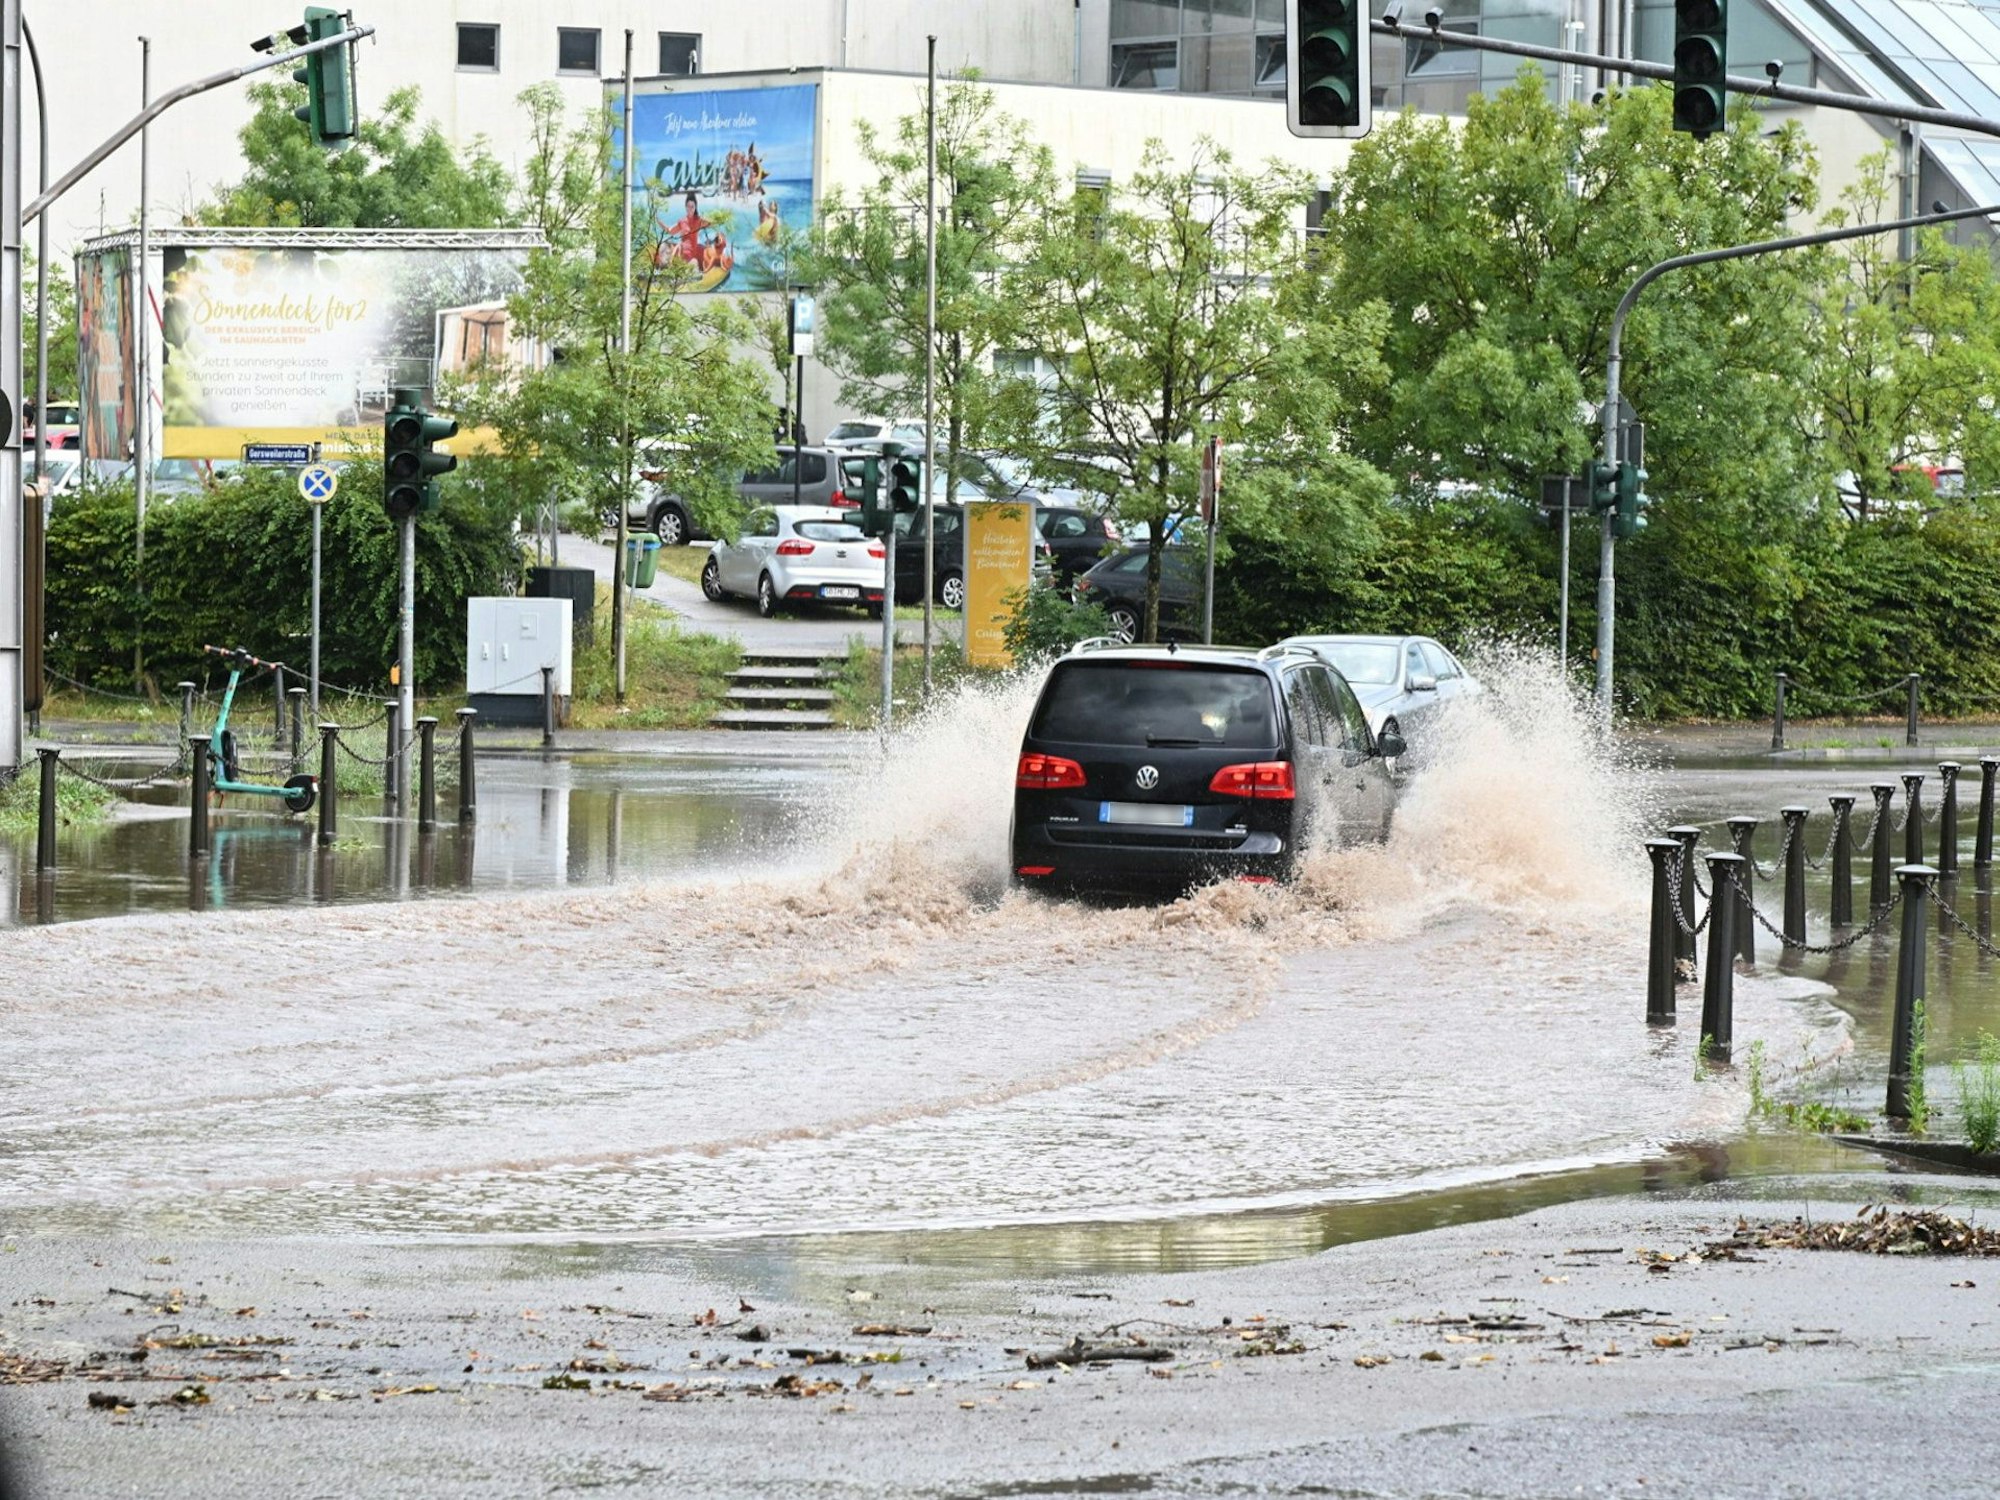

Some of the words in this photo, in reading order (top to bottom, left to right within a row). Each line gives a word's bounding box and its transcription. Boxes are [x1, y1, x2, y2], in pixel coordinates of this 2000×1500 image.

[193, 285, 324, 326] Sonnendeck
[204, 326, 223, 334] DER
[226, 326, 279, 334] EXKLUSIVE
[281, 326, 321, 334] BEREICH
[234, 336, 306, 344] SAUNAGARTEN
[201, 356, 230, 367] Jetzt
[186, 370, 235, 381] Stunden
[238, 373, 250, 381] zu
[254, 370, 284, 381] zweit
[287, 370, 307, 381] auf
[310, 370, 344, 381] Ihrem
[202, 384, 250, 398] privaten
[254, 384, 327, 397] Sonnendeck
[230, 399, 287, 412] genießen
[248, 448, 306, 459] Gersweilerstraße
